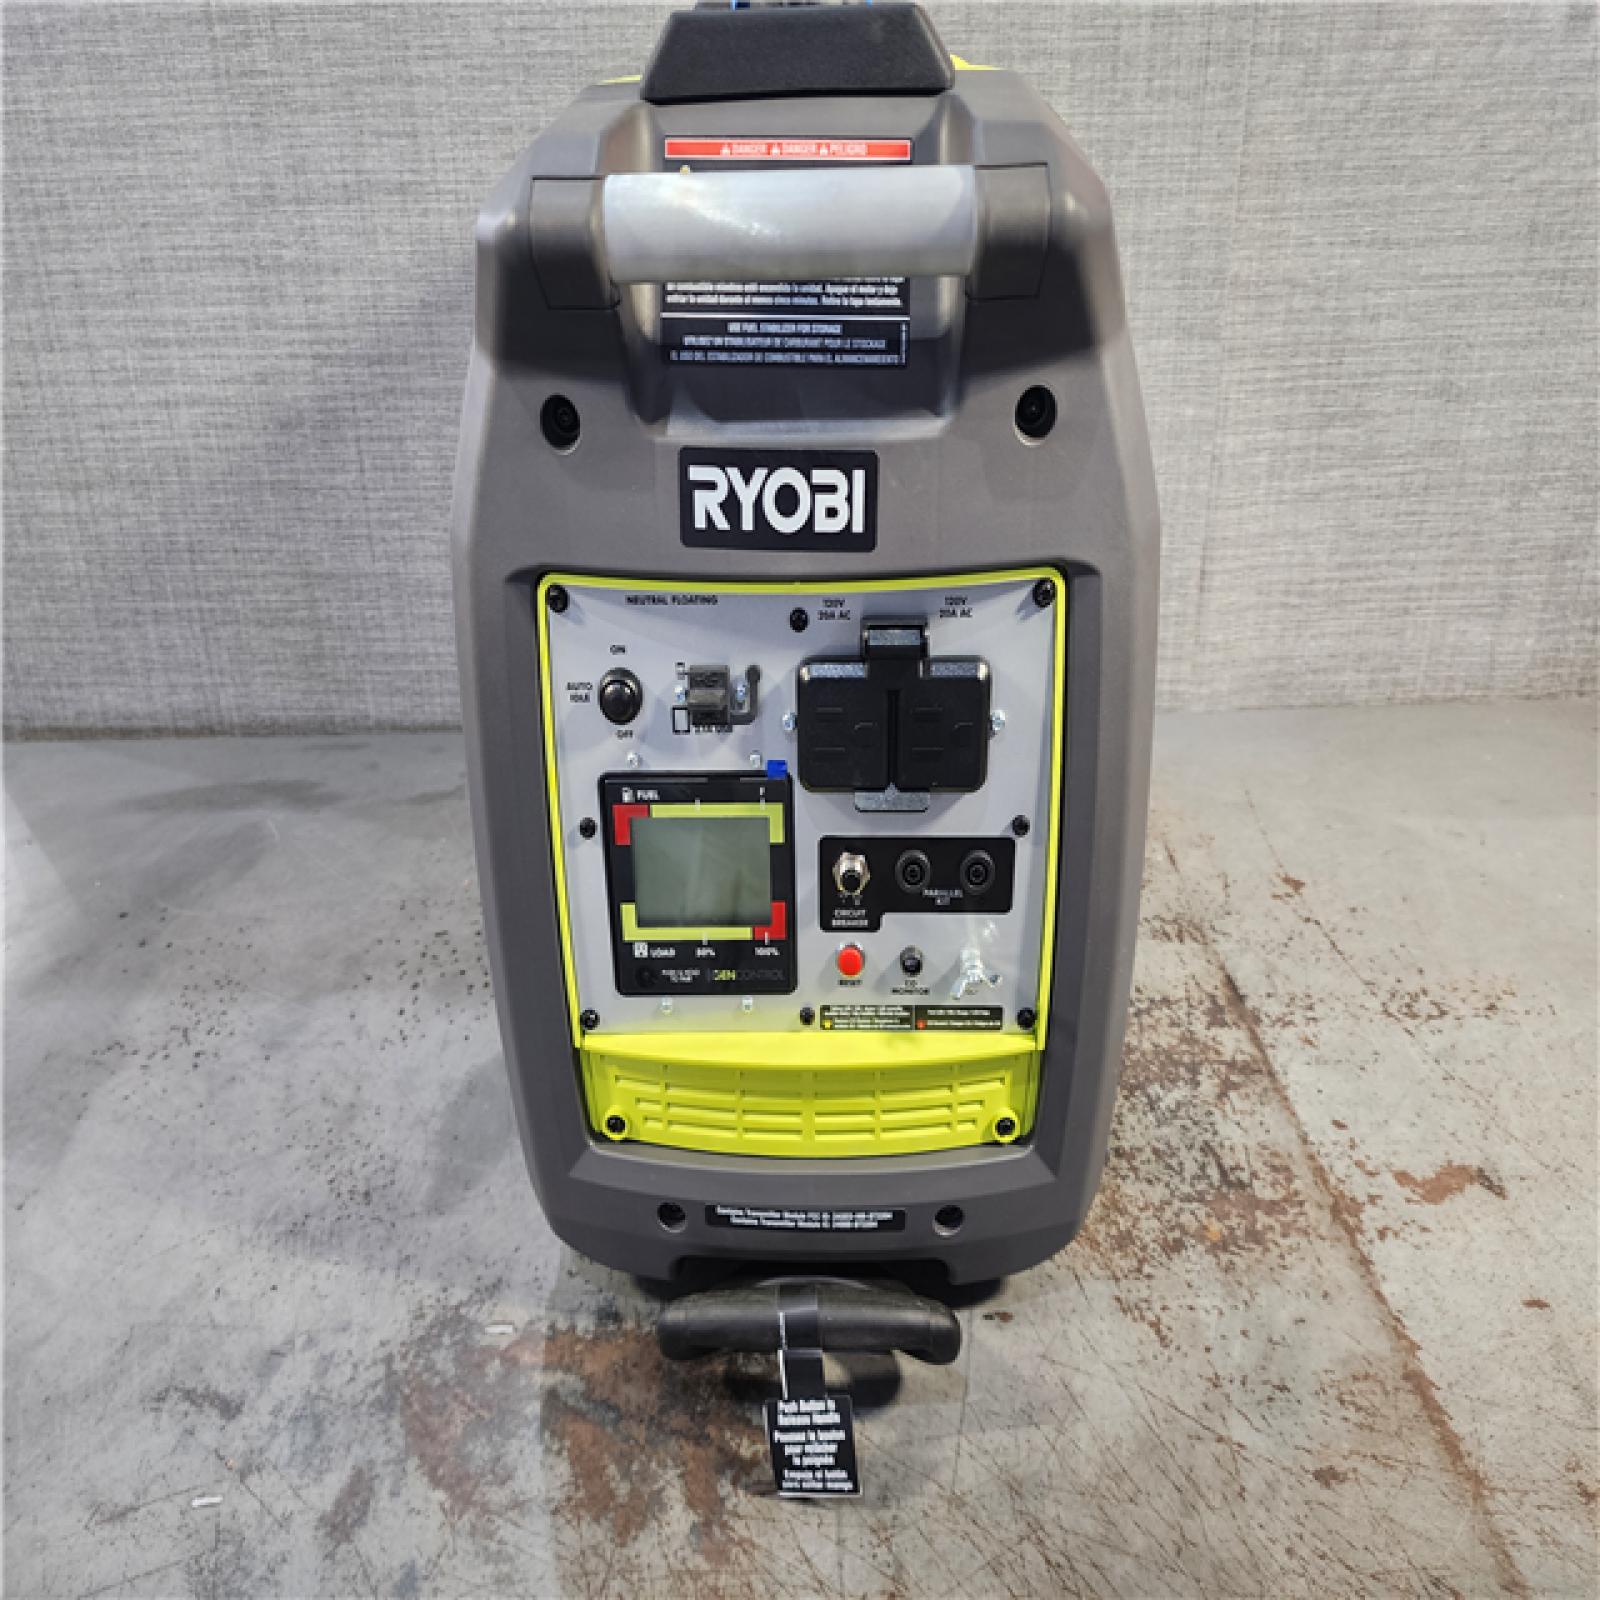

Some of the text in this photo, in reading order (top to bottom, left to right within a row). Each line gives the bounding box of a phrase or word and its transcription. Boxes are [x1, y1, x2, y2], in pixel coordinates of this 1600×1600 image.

[732, 143, 867, 155] DANGER DANGER PELIGRO
[688, 464, 865, 534] RYOBI
[625, 595, 719, 605] NEUTRAL FLOATING
[823, 599, 845, 608] 120V
[945, 596, 968, 605] 120V
[838, 610, 850, 620] AC
[960, 608, 972, 618] AC
[610, 645, 626, 655] ON
[567, 682, 593, 690] AUTO
[570, 693, 590, 702] IDLE
[616, 730, 633, 738] OFF
[637, 789, 660, 800] FUEL
[923, 889, 963, 897] PARALLEL
[835, 909, 866, 917] CIRCUIT
[832, 919, 868, 927] BREAKER
[650, 948, 676, 957] LOAD
[755, 947, 780, 956] 100%
[777, 1400, 798, 1413] Push
[800, 1400, 825, 1411] Button
[777, 1412, 840, 1426] Release Handle
